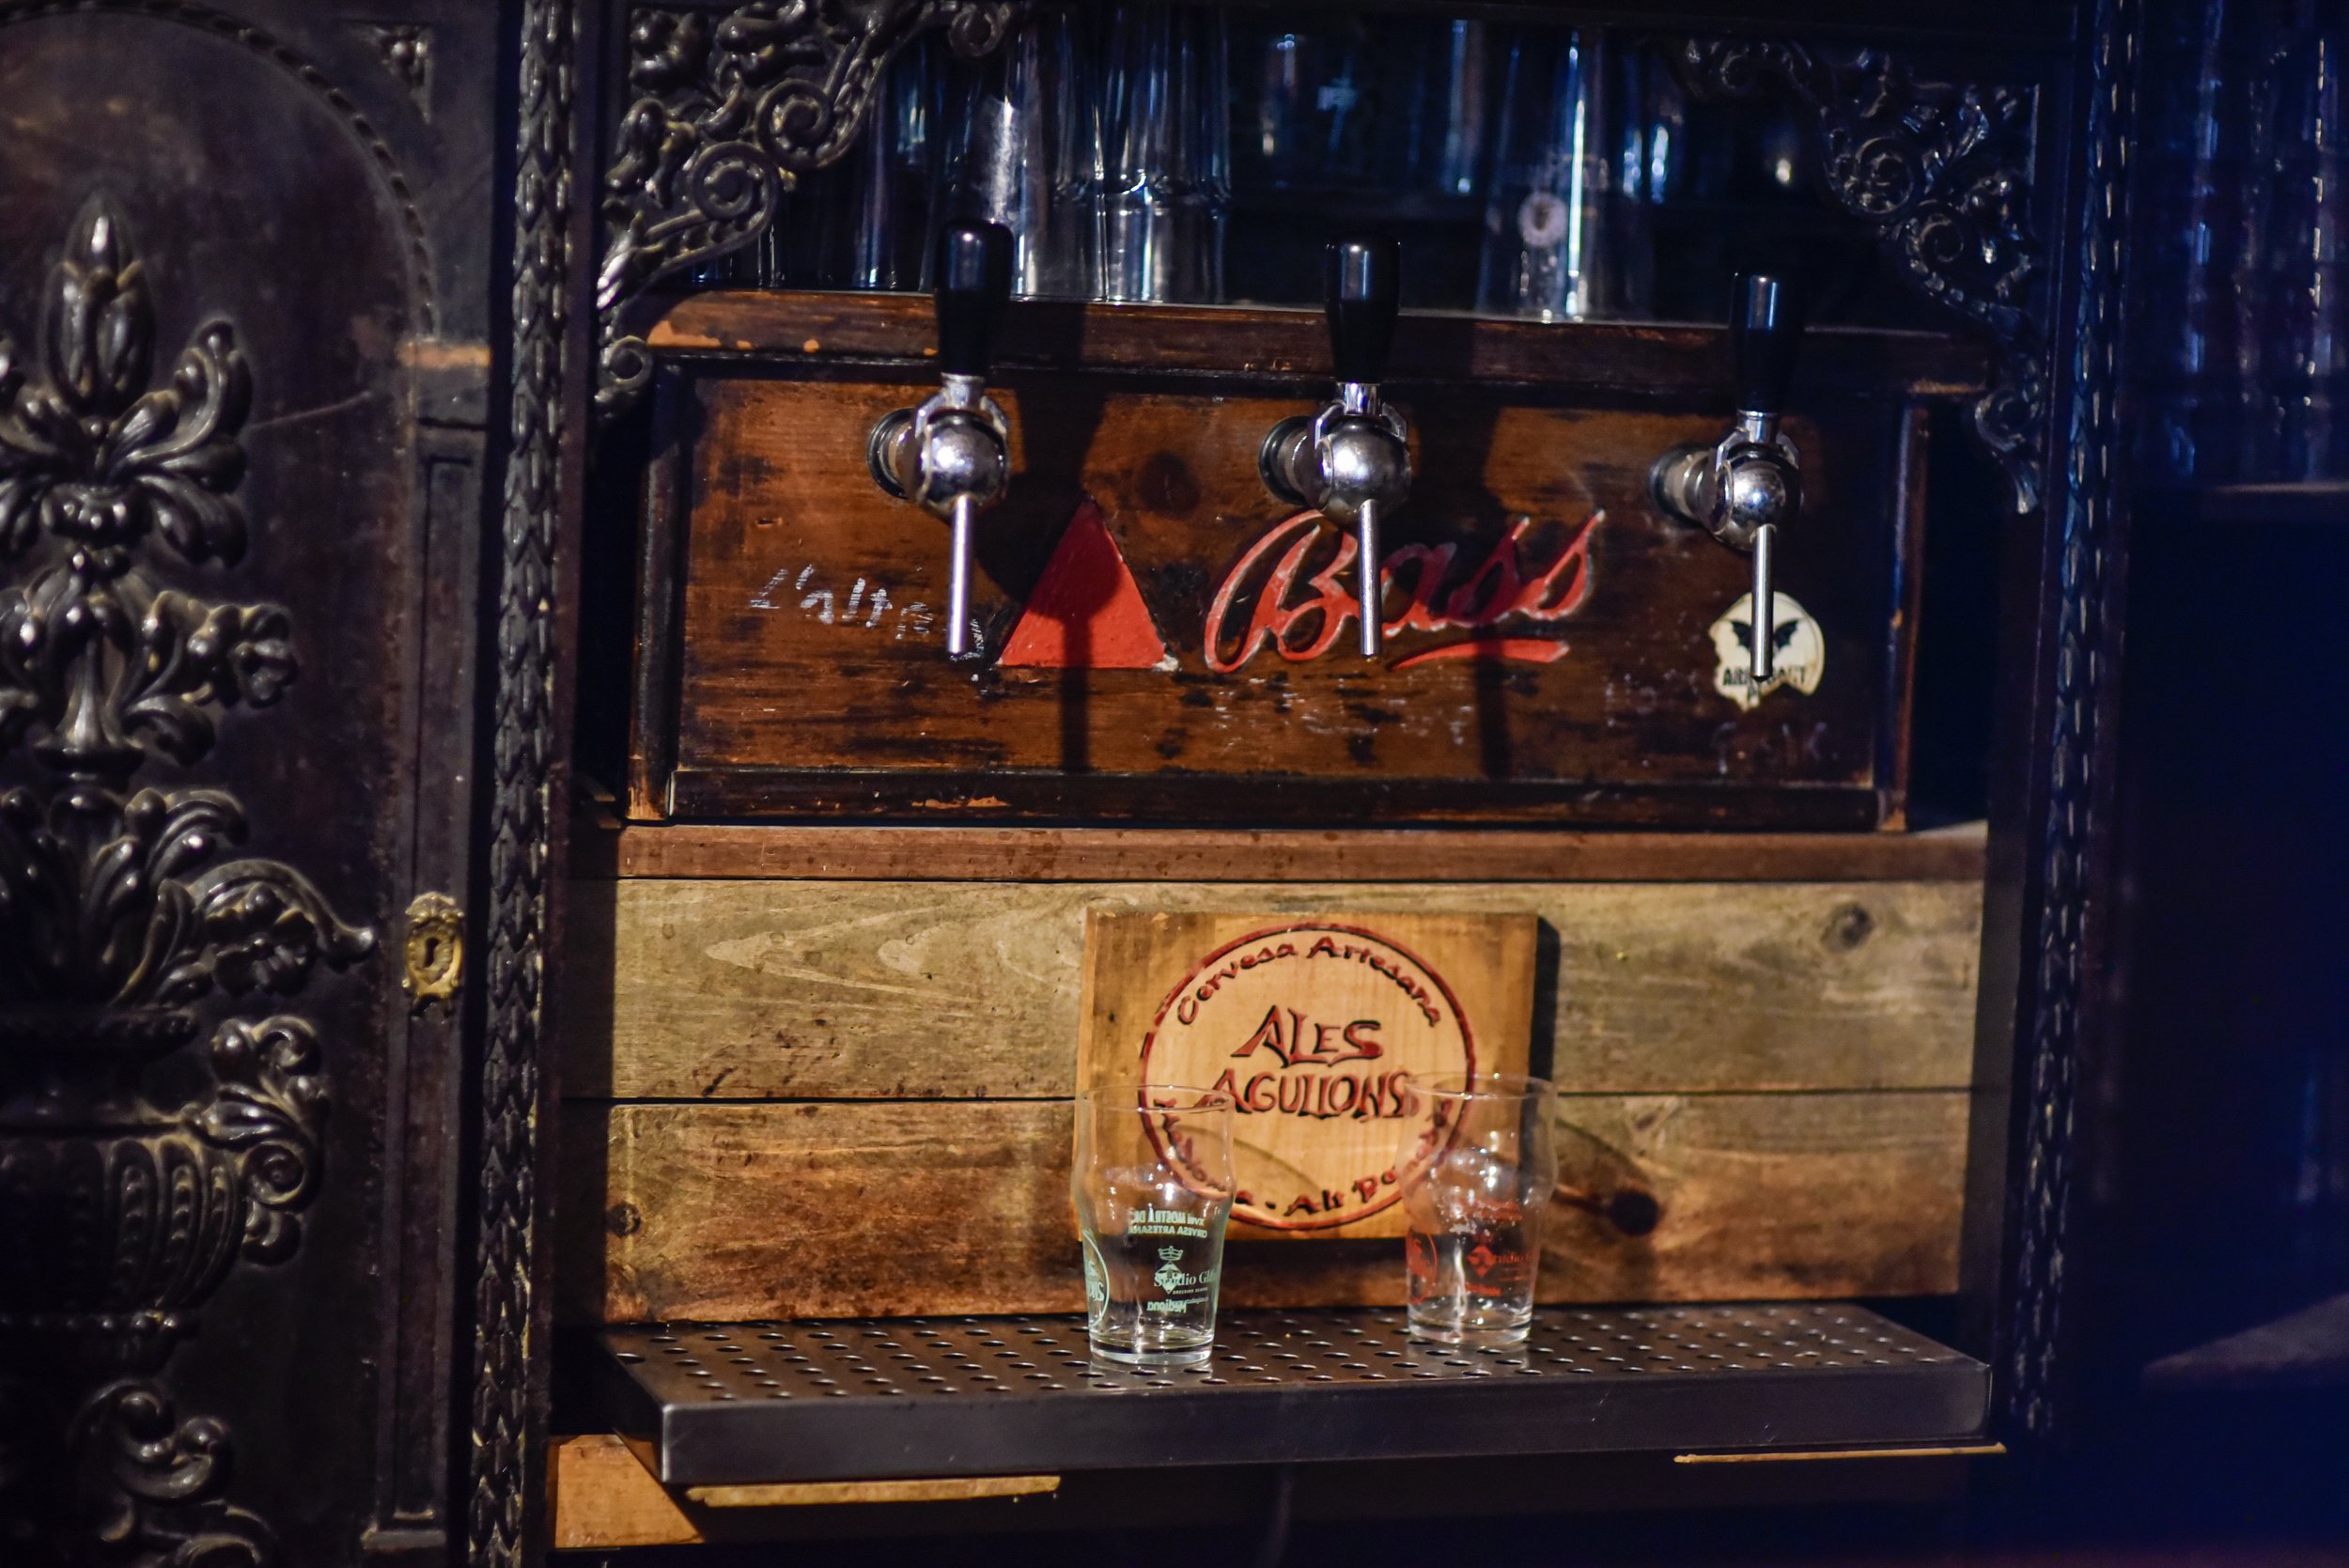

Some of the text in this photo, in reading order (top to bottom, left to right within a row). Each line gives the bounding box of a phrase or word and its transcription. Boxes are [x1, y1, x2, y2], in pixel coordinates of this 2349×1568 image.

[1205, 508, 1606, 674] Bass
[1177, 936, 1440, 1027] Cervesa Artesana
[1230, 1004, 1384, 1068] ALES
